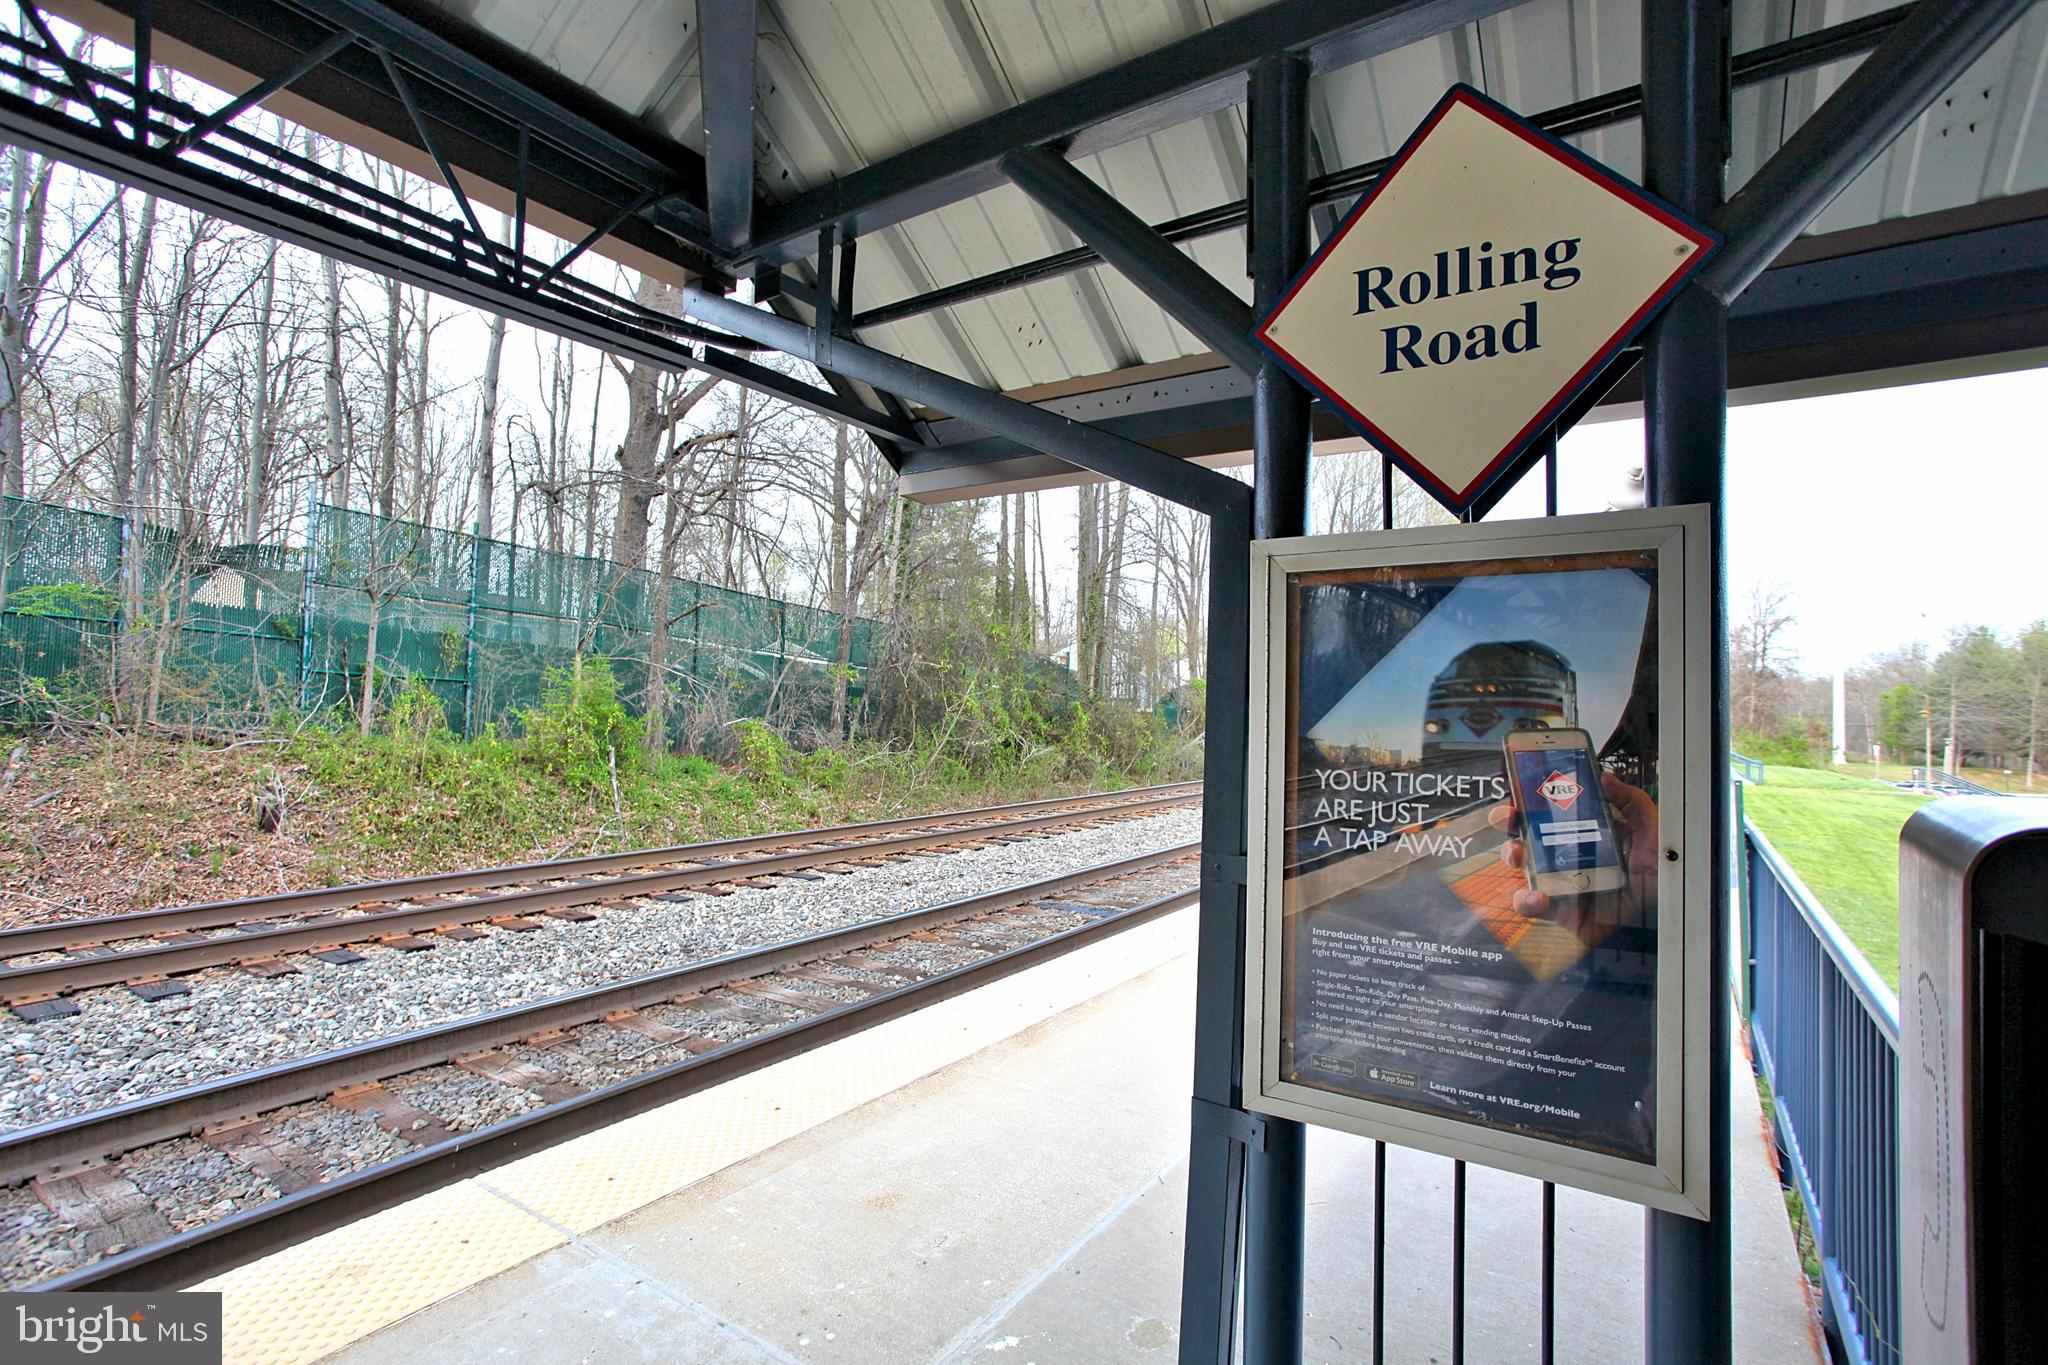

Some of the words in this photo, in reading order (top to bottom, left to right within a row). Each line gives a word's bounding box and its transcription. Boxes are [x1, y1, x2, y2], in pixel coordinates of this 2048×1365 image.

[1352, 237, 1582, 316] Rolling
[1379, 301, 1541, 374] Road
[1315, 769, 1388, 793] YOUR
[1391, 772, 1505, 800] TICKETS
[1544, 784, 1577, 795] VRE
[1314, 798, 1363, 821] ARE
[1368, 801, 1429, 828] JUST
[1314, 826, 1332, 848] A
[1340, 828, 1387, 851] TAP
[1395, 833, 1473, 858] AWAY
[1312, 927, 1369, 944] Introducing
[1371, 936, 1389, 945] the
[1391, 938, 1412, 948] free
[1415, 941, 1438, 951] VRE
[1441, 945, 1478, 957] Mobile
[1481, 951, 1503, 961] app
[1312, 938, 1327, 947] Buy
[1329, 940, 1342, 948] and
[1359, 944, 1377, 954] VRE
[1379, 948, 1405, 958] tickets
[1408, 952, 1422, 960] and
[1425, 955, 1452, 964] passes
[1312, 949, 1330, 957] right
[1332, 950, 1350, 959] from
[1352, 954, 1371, 962] your
[1373, 958, 1423, 970] smartphone!
[1349, 974, 1370, 982] tickets
[1399, 982, 1416, 990] track
[1316, 989, 1345, 999] delivered
[1347, 993, 1370, 1003] straight
[1399, 1003, 1440, 1014] smartphone
[1387, 991, 1400, 1000] Day
[1454, 1002, 1484, 1014] Monthly
[1486, 1008, 1499, 1016] and
[1500, 1010, 1530, 1021] Amtrak
[1532, 1015, 1564, 1028] Step-Up
[1566, 1021, 1592, 1031] Passes
[1316, 1011, 1329, 1020] Split
[1346, 1018, 1371, 1027] payment
[1373, 1022, 1400, 1032] between
[1416, 1030, 1435, 1039] credit
[1474, 1041, 1494, 1049] credit
[1512, 1048, 1525, 1056] and
[1594, 1061, 1626, 1072] account
[1384, 1013, 1408, 1021] vendor
[1410, 1016, 1437, 1026] location
[1450, 1024, 1469, 1032] ticket
[1471, 1028, 1499, 1039] vending
[1500, 1032, 1531, 1043] machine
[1316, 1024, 1344, 1034] Purchase
[1346, 1030, 1366, 1038] tickets
[1439, 1047, 1454, 1055] then
[1457, 1050, 1484, 1060] validate
[1486, 1055, 1504, 1064] them
[1506, 1059, 1535, 1072] directly
[1537, 1065, 1556, 1074] from
[1377, 1045, 1406, 1056] boarding
[1381, 1074, 1395, 1083] App
[1396, 1077, 1414, 1087] Store
[1430, 1082, 1456, 1093] Learn
[1459, 1089, 1484, 1100] more
[1499, 1096, 1580, 1119] VRE.org/Mobile
